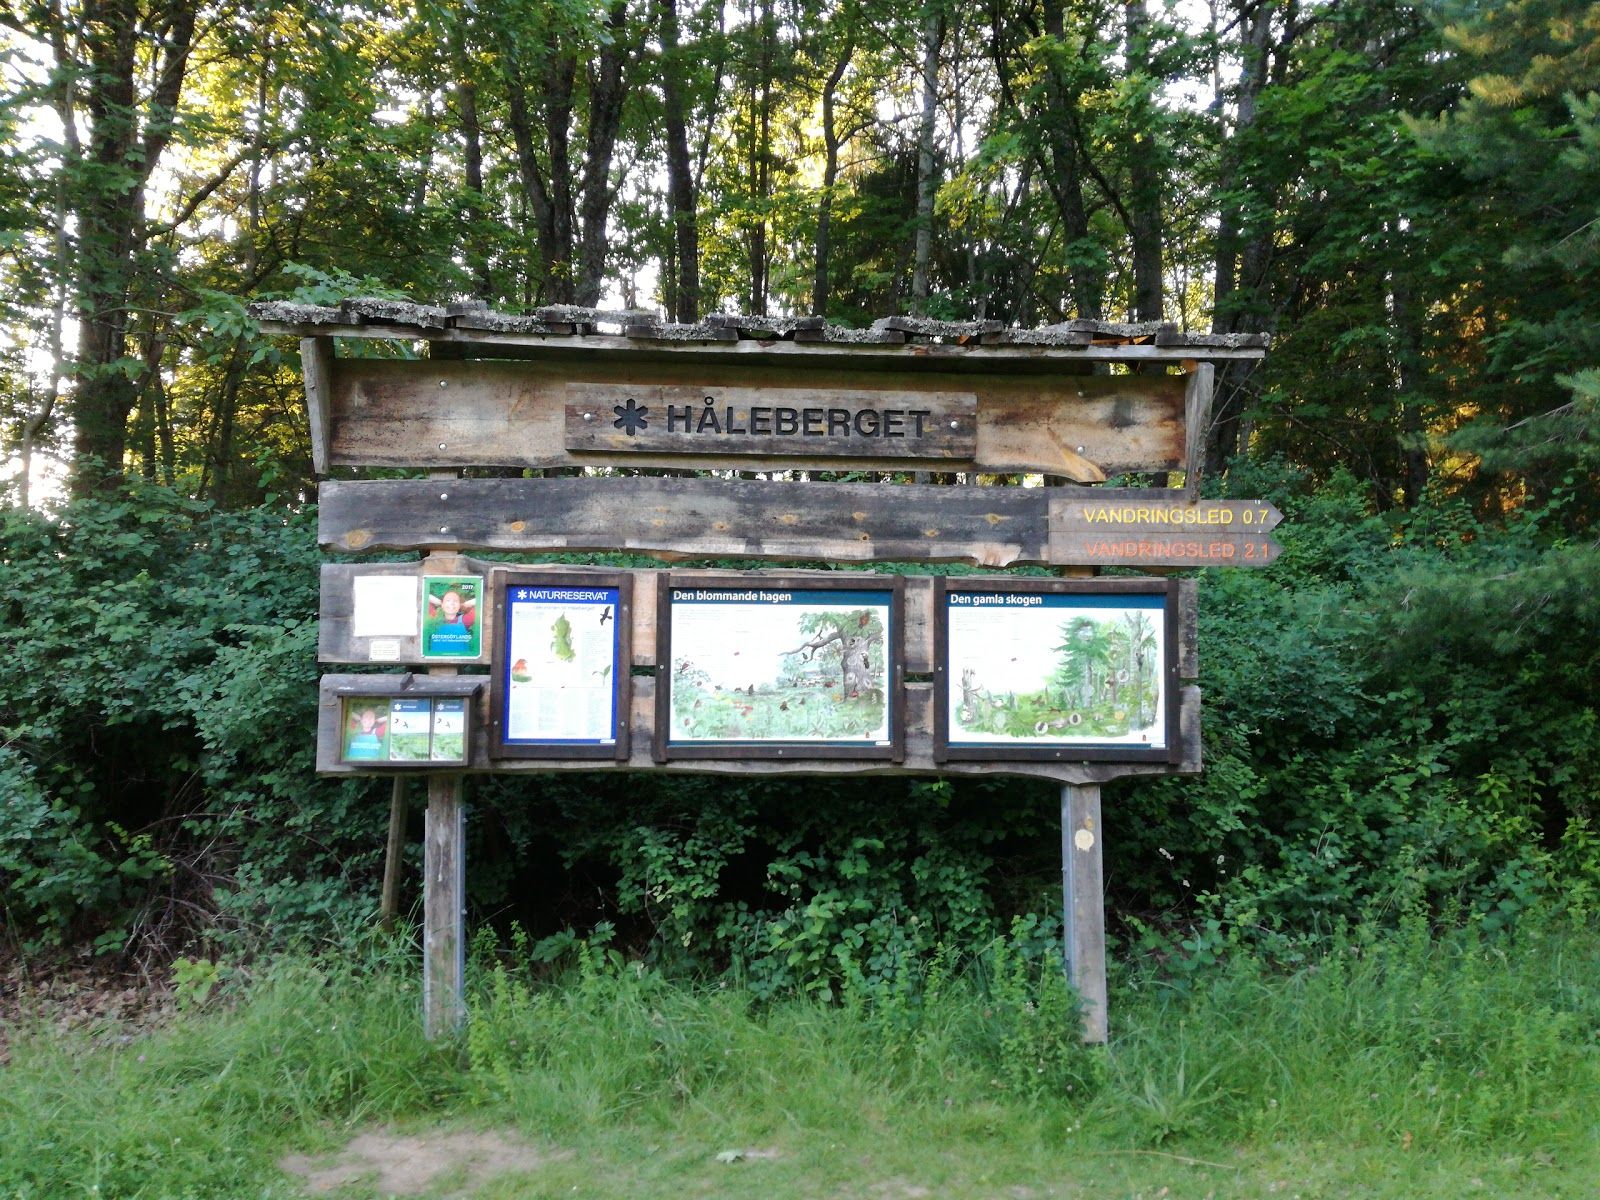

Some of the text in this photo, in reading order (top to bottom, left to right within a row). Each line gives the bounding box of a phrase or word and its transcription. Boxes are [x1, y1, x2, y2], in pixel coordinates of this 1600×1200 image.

[667, 395, 931, 438] HÅLEBERGET
[1083, 508, 1269, 525] VANDRINGSLED 0.7
[1085, 542, 1269, 559] VANDRINGSLED 2.1
[529, 590, 608, 601] NATURRESERVAT
[673, 591, 792, 603] Den blommande hagen
[950, 594, 1042, 606] Den gamla skogen
